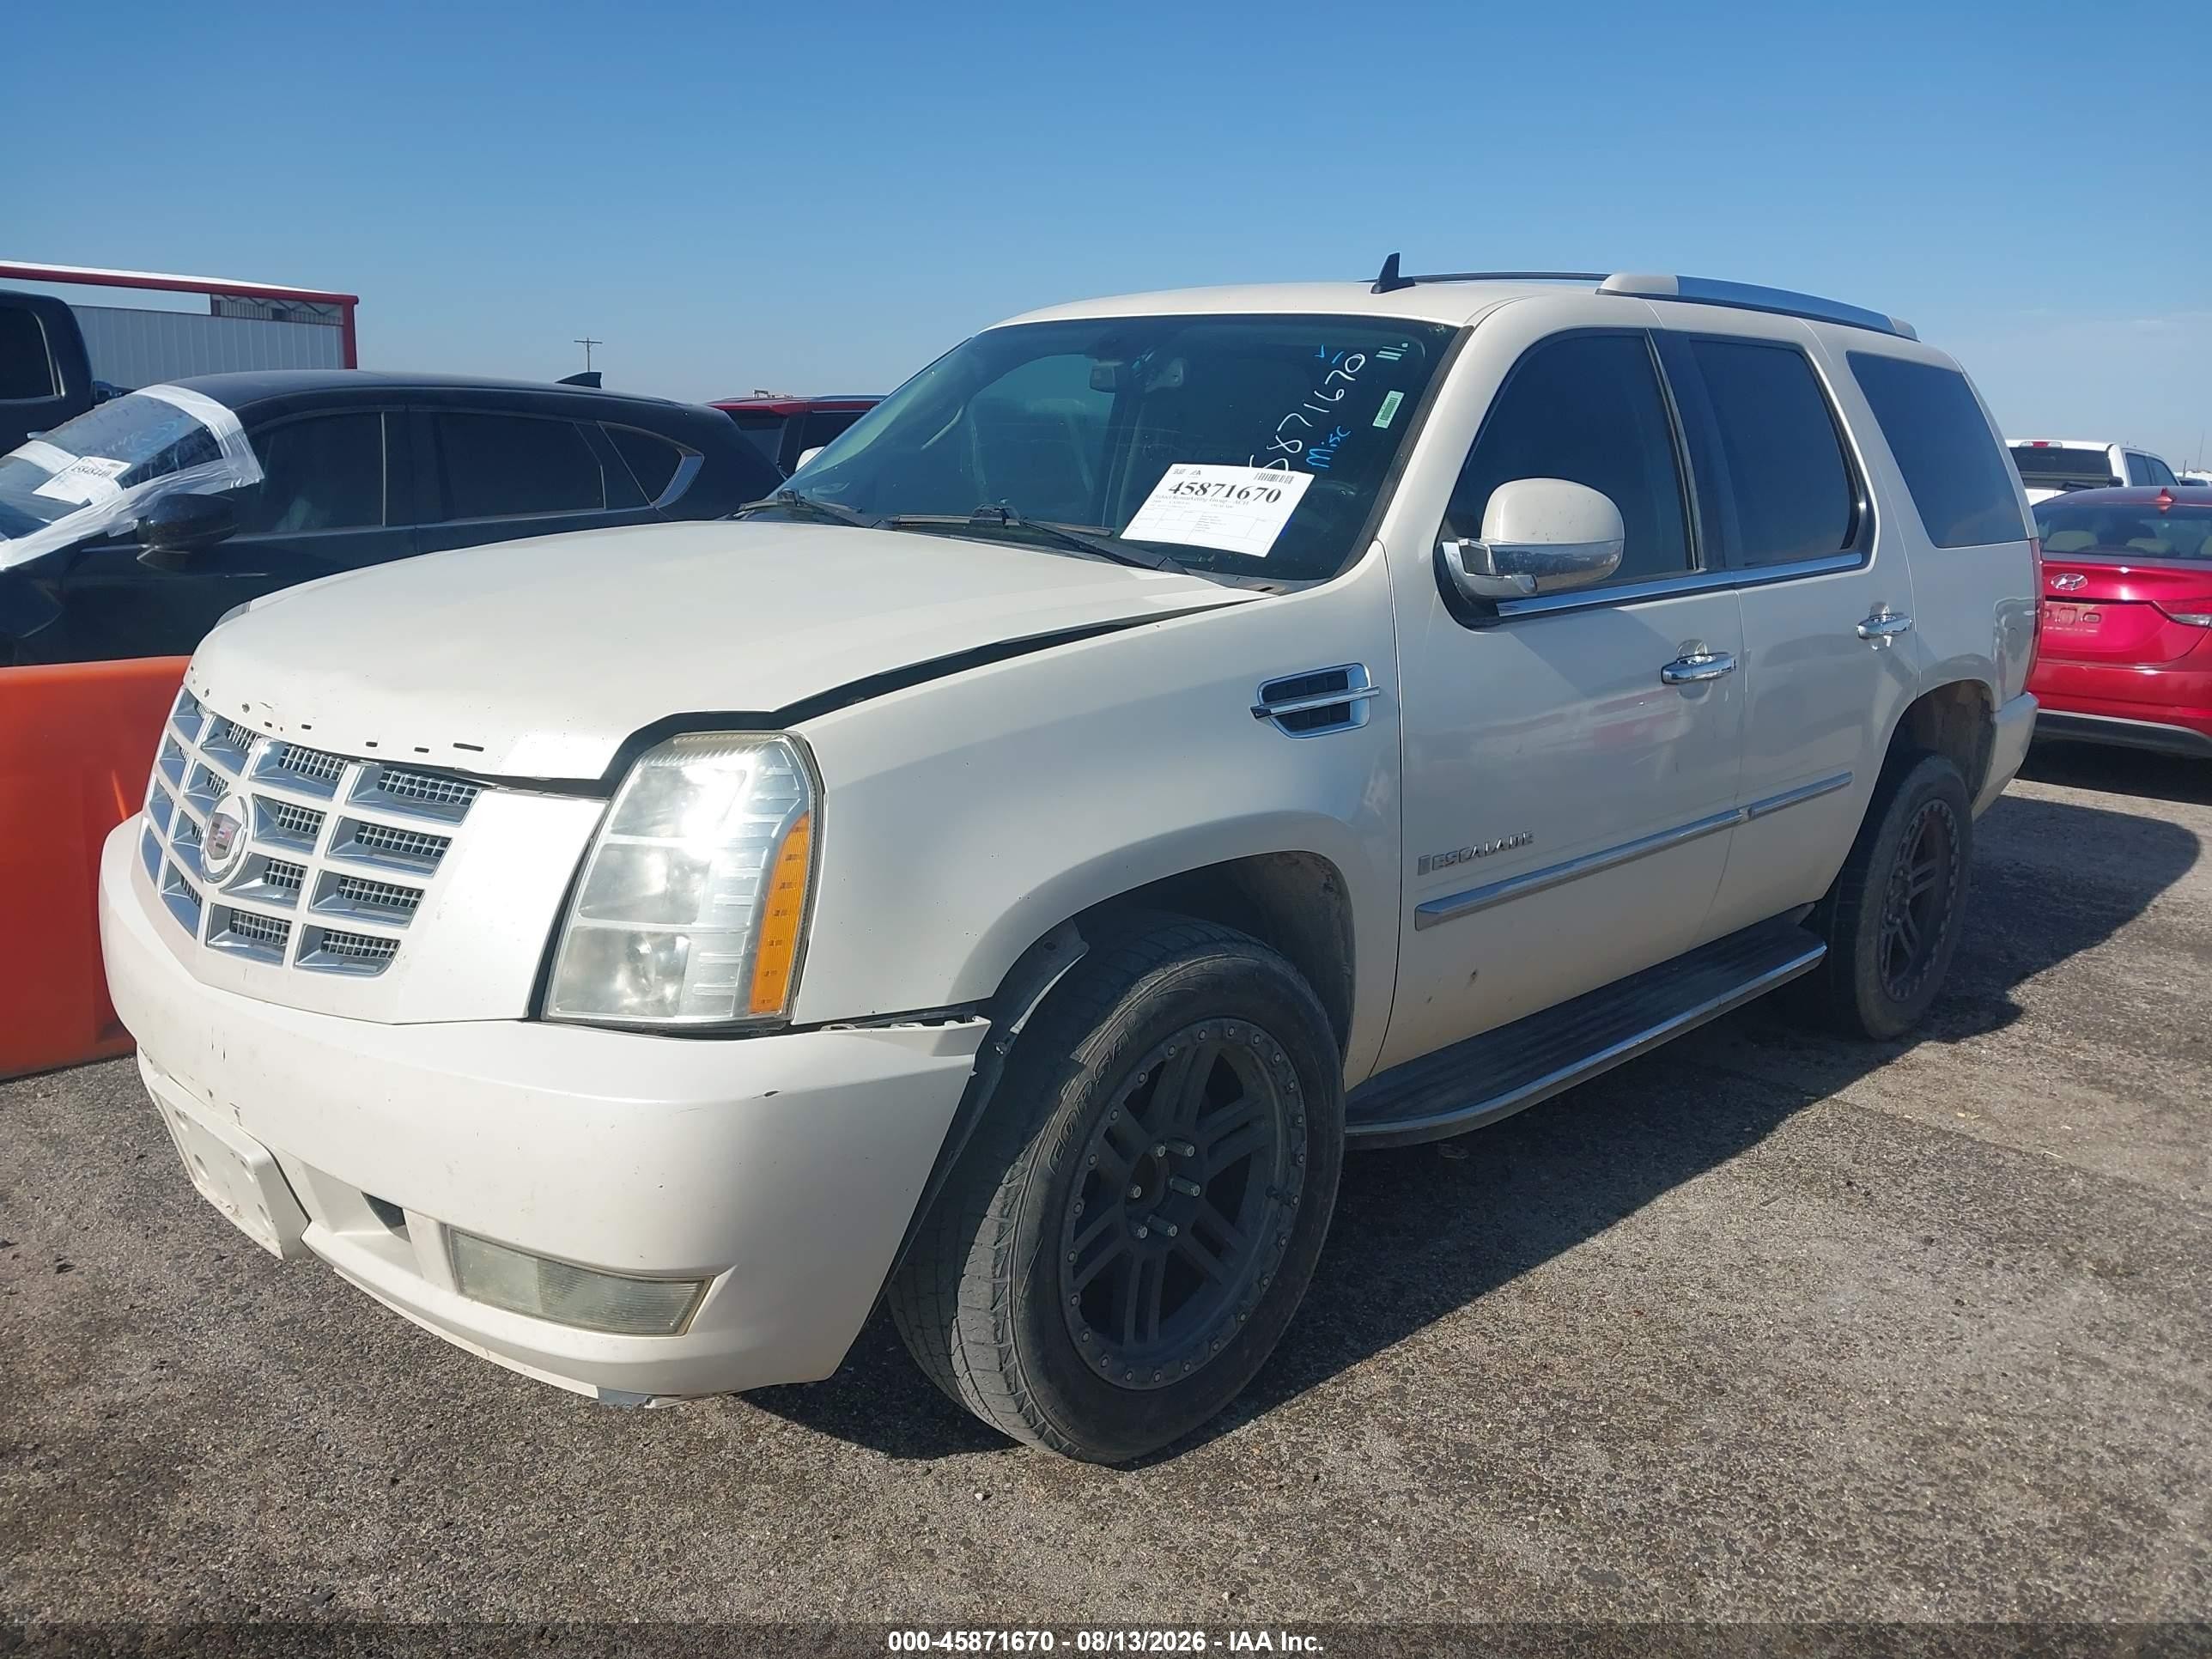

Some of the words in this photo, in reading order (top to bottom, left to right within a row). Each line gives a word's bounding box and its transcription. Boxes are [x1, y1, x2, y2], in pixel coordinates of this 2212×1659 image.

[1305, 425, 1352, 469] Misc
[1168, 481, 1283, 504] 45871670
[1431, 830, 1534, 872] ESCALADE
